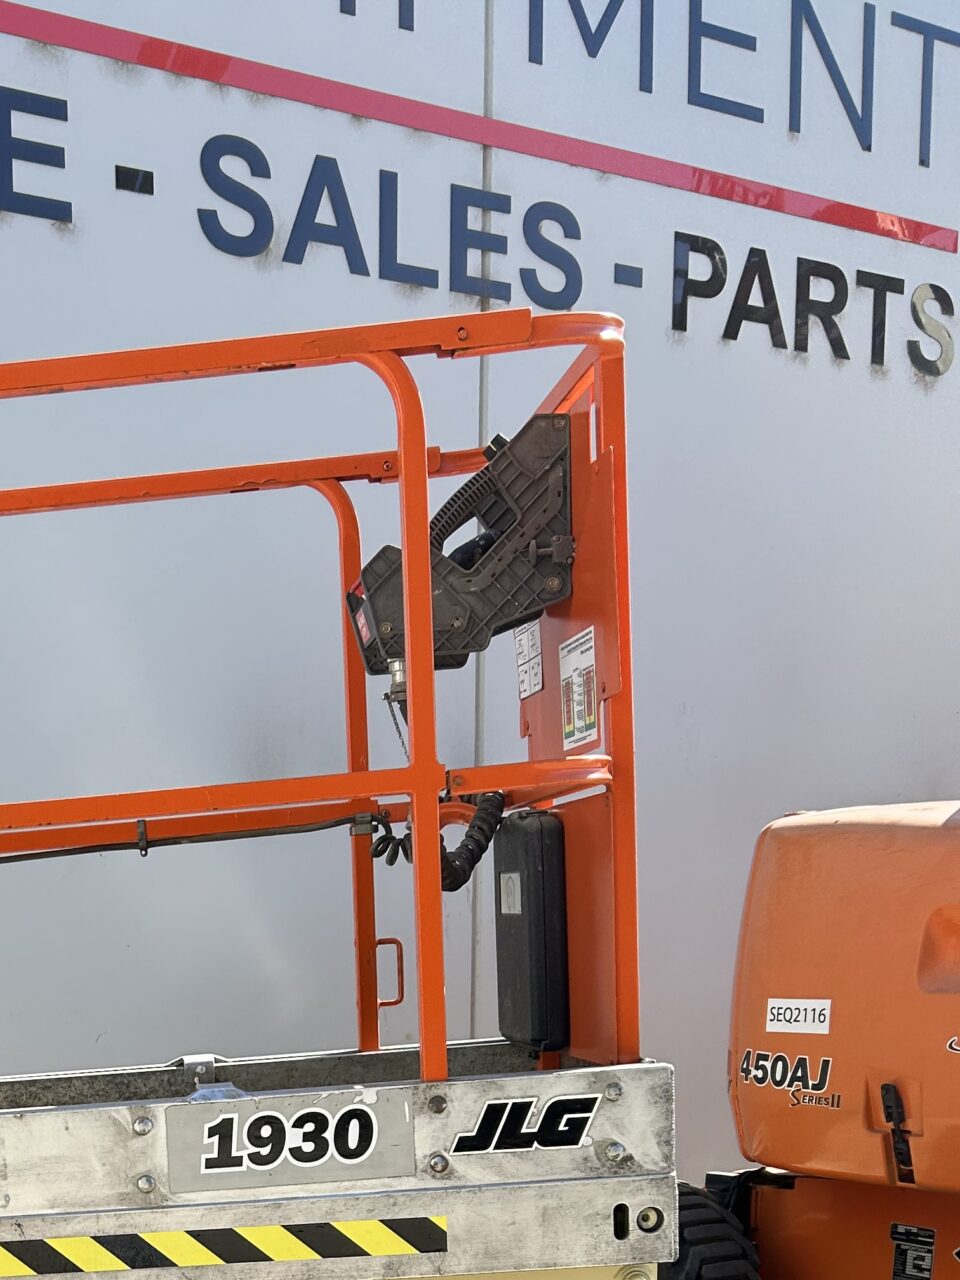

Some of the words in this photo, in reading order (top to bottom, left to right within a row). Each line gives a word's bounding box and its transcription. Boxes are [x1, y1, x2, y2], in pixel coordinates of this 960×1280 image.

[340, 0, 960, 168] MENT
[197, 134, 583, 310] SALES
[672, 231, 955, 377] PARTS
[769, 1006, 826, 1024] SEQ2116
[740, 1048, 832, 1093] 450AJ
[200, 1103, 378, 1175] 1930
[451, 1094, 602, 1155] JLG
